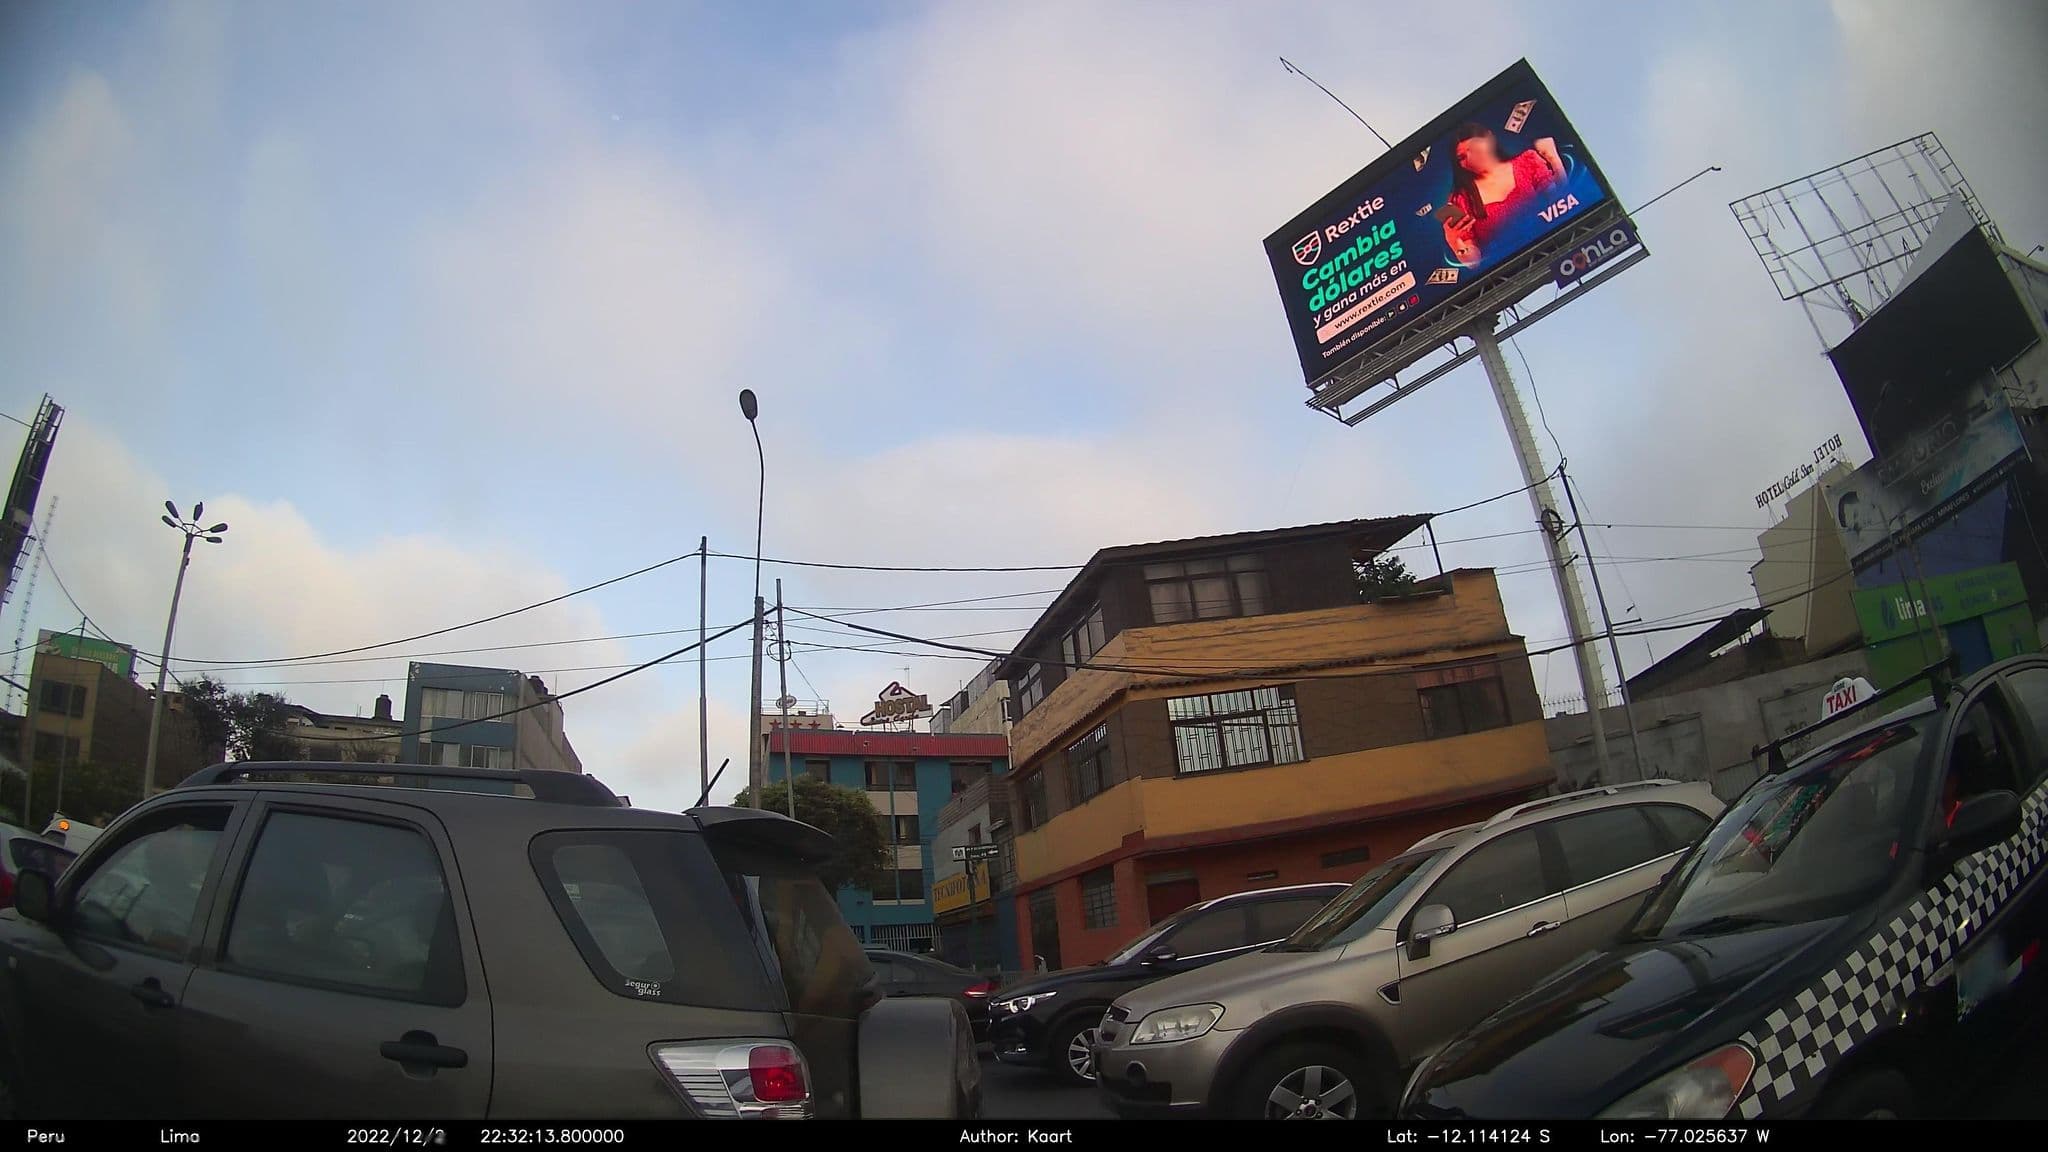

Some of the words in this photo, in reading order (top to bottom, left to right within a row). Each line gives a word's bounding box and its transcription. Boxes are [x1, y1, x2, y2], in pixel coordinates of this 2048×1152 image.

[1325, 196, 1385, 243] Rextie
[1538, 193, 1580, 222] VISA
[1302, 220, 1396, 290] Cambia
[1309, 241, 1404, 312] dólares
[1312, 314, 1322, 329] y
[1324, 293, 1357, 322] gana
[1360, 273, 1388, 297] más
[1390, 260, 1408, 276] en
[1334, 281, 1406, 330] www.rextie.com
[1322, 338, 1351, 359] También
[1755, 482, 1785, 508] HOTEL
[874, 694, 931, 718] HOSTAL
[1827, 685, 1856, 713] TAXI
